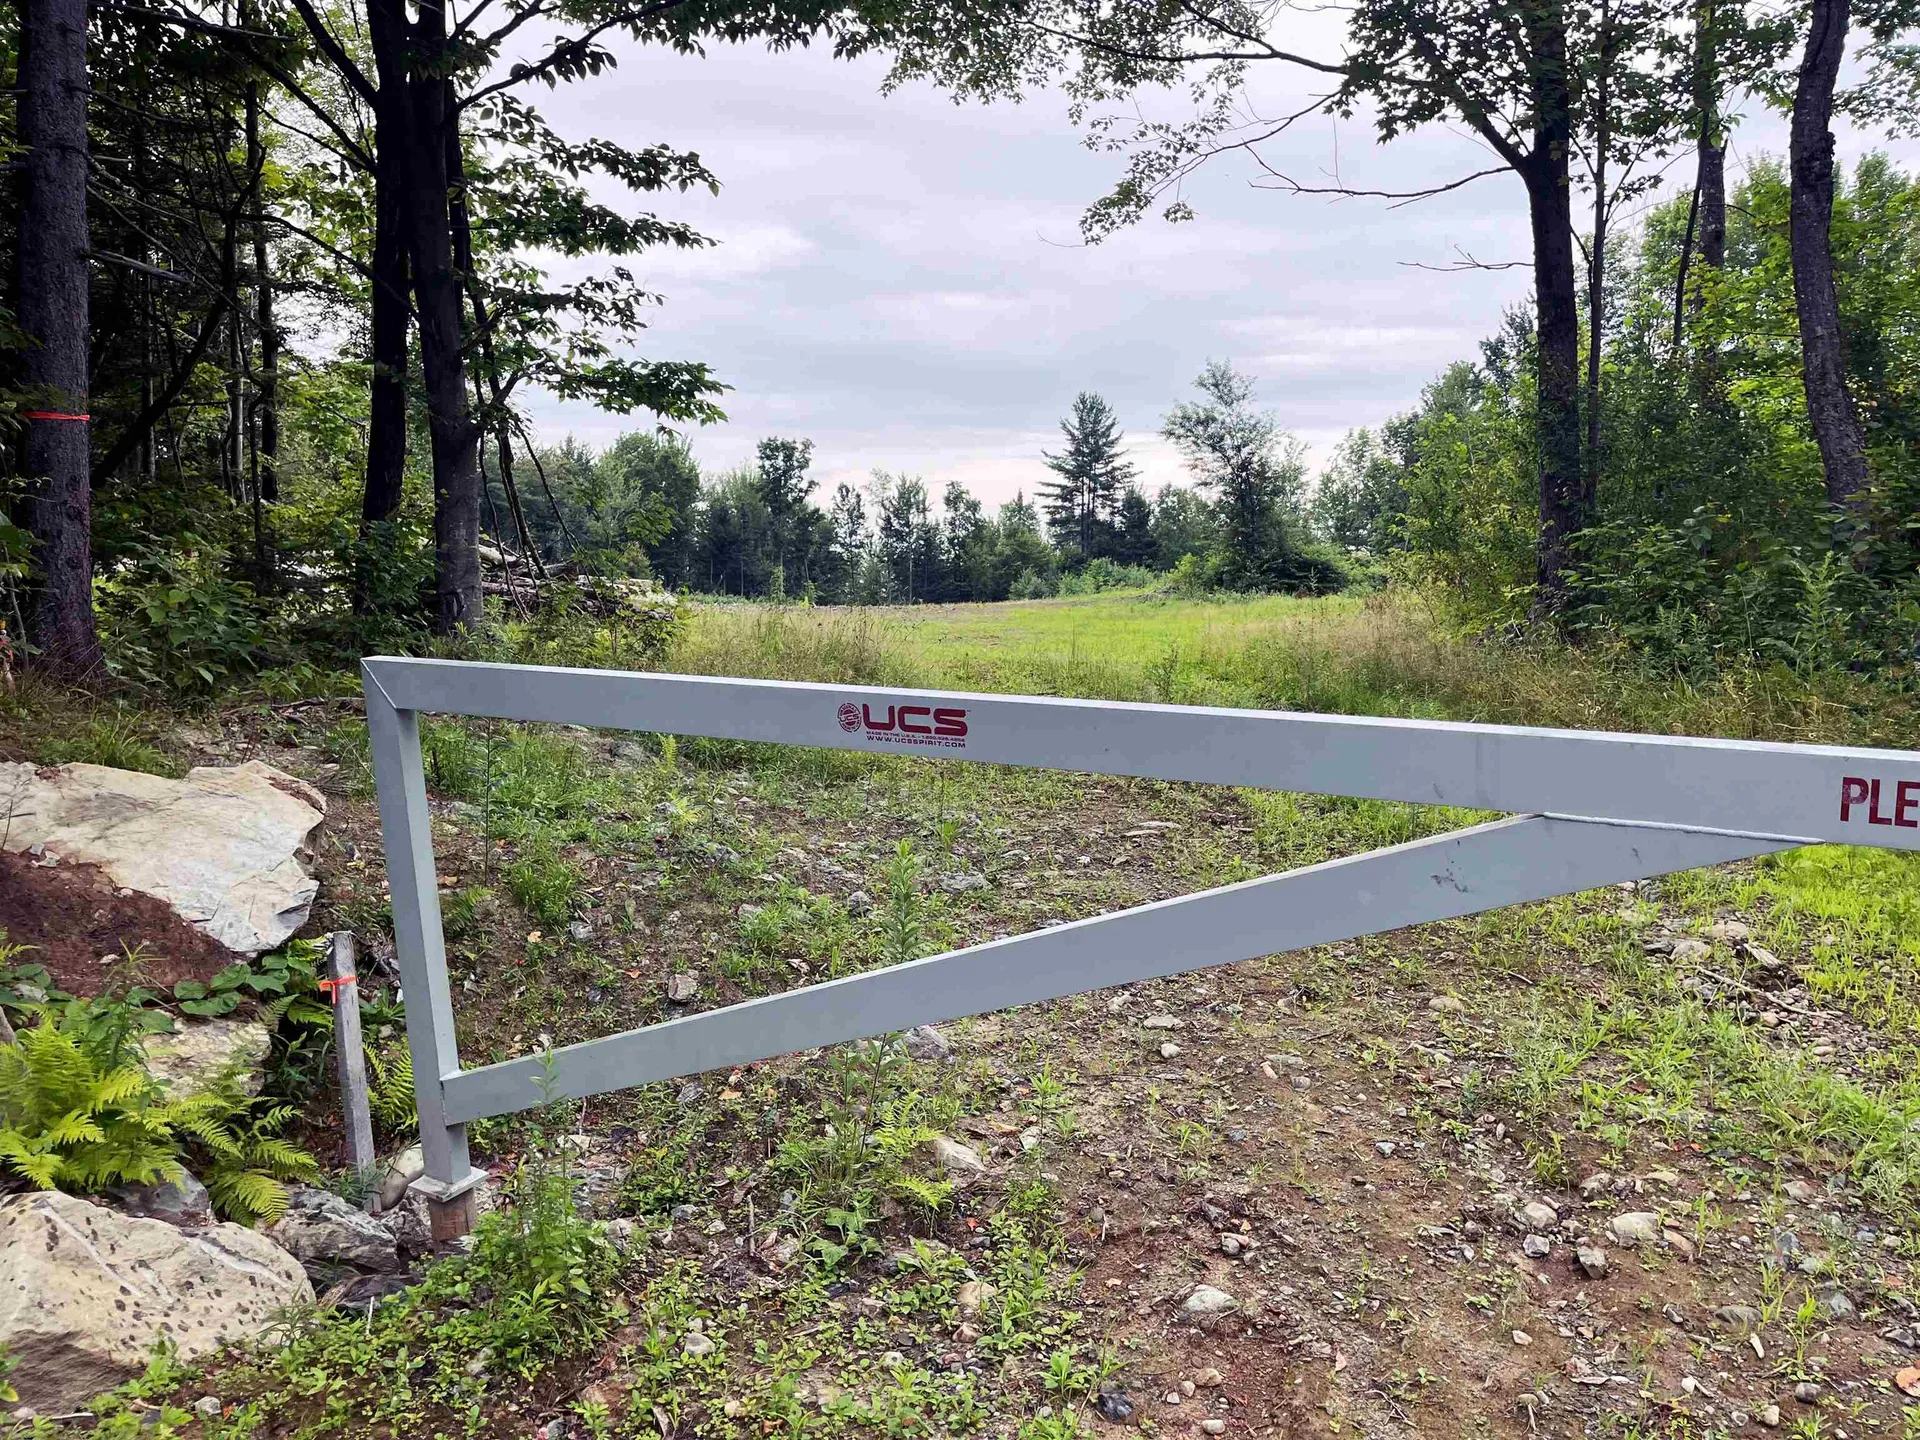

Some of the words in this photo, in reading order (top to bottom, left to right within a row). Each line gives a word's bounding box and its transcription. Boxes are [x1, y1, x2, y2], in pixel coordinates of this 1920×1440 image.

[862, 703, 968, 737] UCS
[866, 735, 966, 748] WWW.UCSSPIRIT.COM
[1840, 777, 1920, 828] PLE
